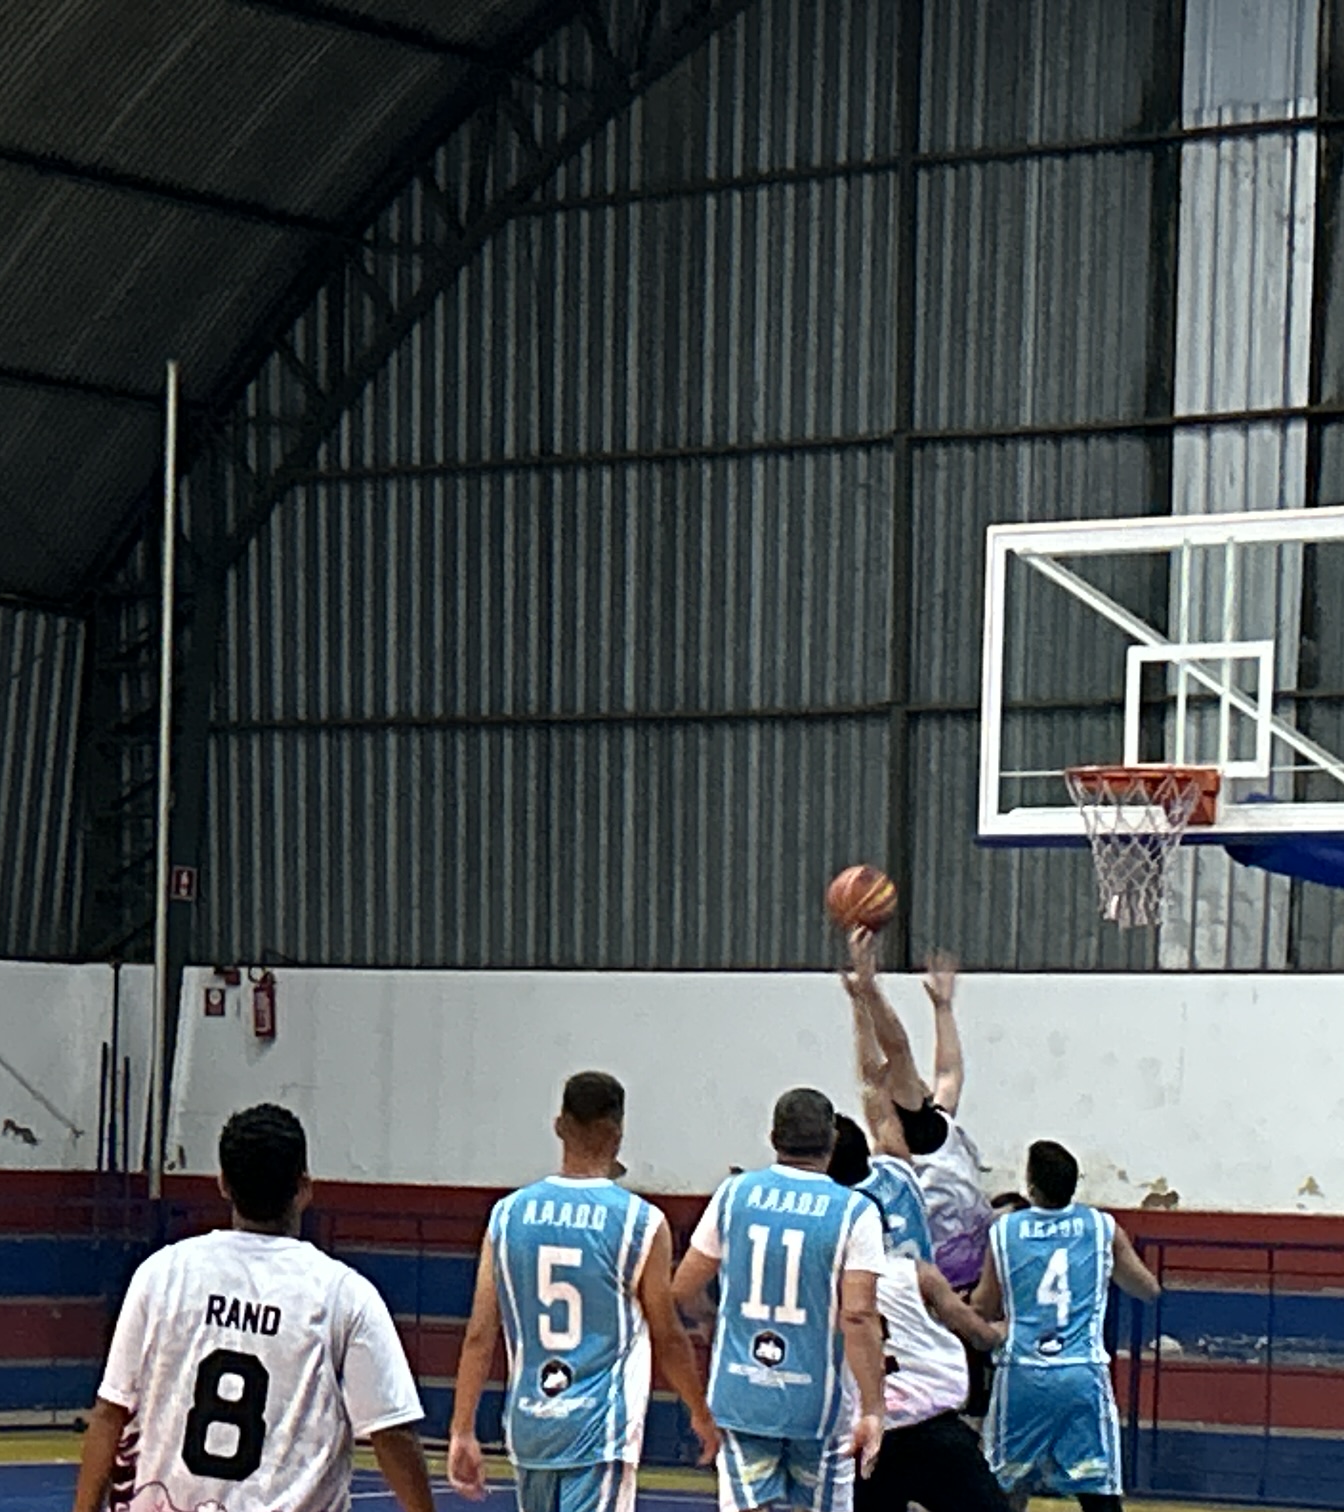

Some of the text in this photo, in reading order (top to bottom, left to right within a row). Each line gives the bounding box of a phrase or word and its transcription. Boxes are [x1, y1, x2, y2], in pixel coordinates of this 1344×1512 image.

[205, 1294, 282, 1337] RAND
[537, 1245, 583, 1350] 5
[740, 1223, 807, 1325] 11
[1036, 1247, 1072, 1328] 4
[182, 1347, 270, 1482] 8
